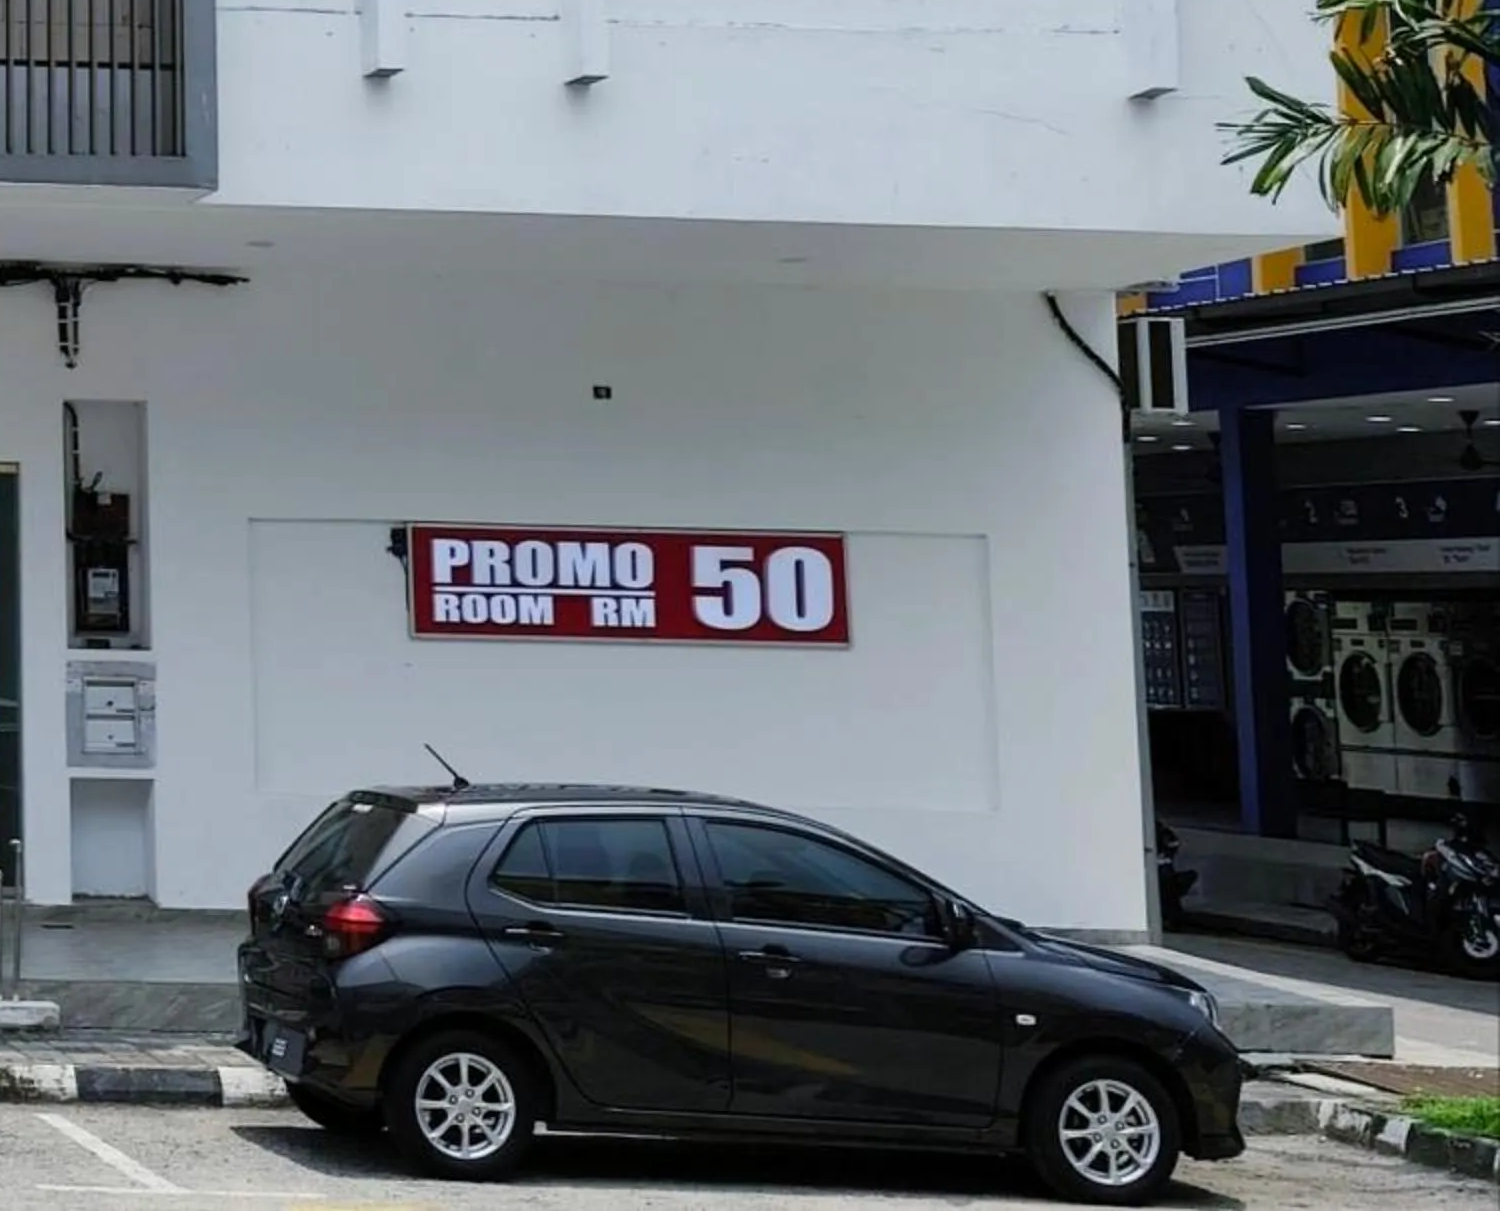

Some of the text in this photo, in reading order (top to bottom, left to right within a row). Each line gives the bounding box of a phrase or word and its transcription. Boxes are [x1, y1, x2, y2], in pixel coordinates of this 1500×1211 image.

[432, 539, 654, 588] PROMO
[433, 593, 655, 627] ROOM RM
[693, 546, 833, 631] 50
